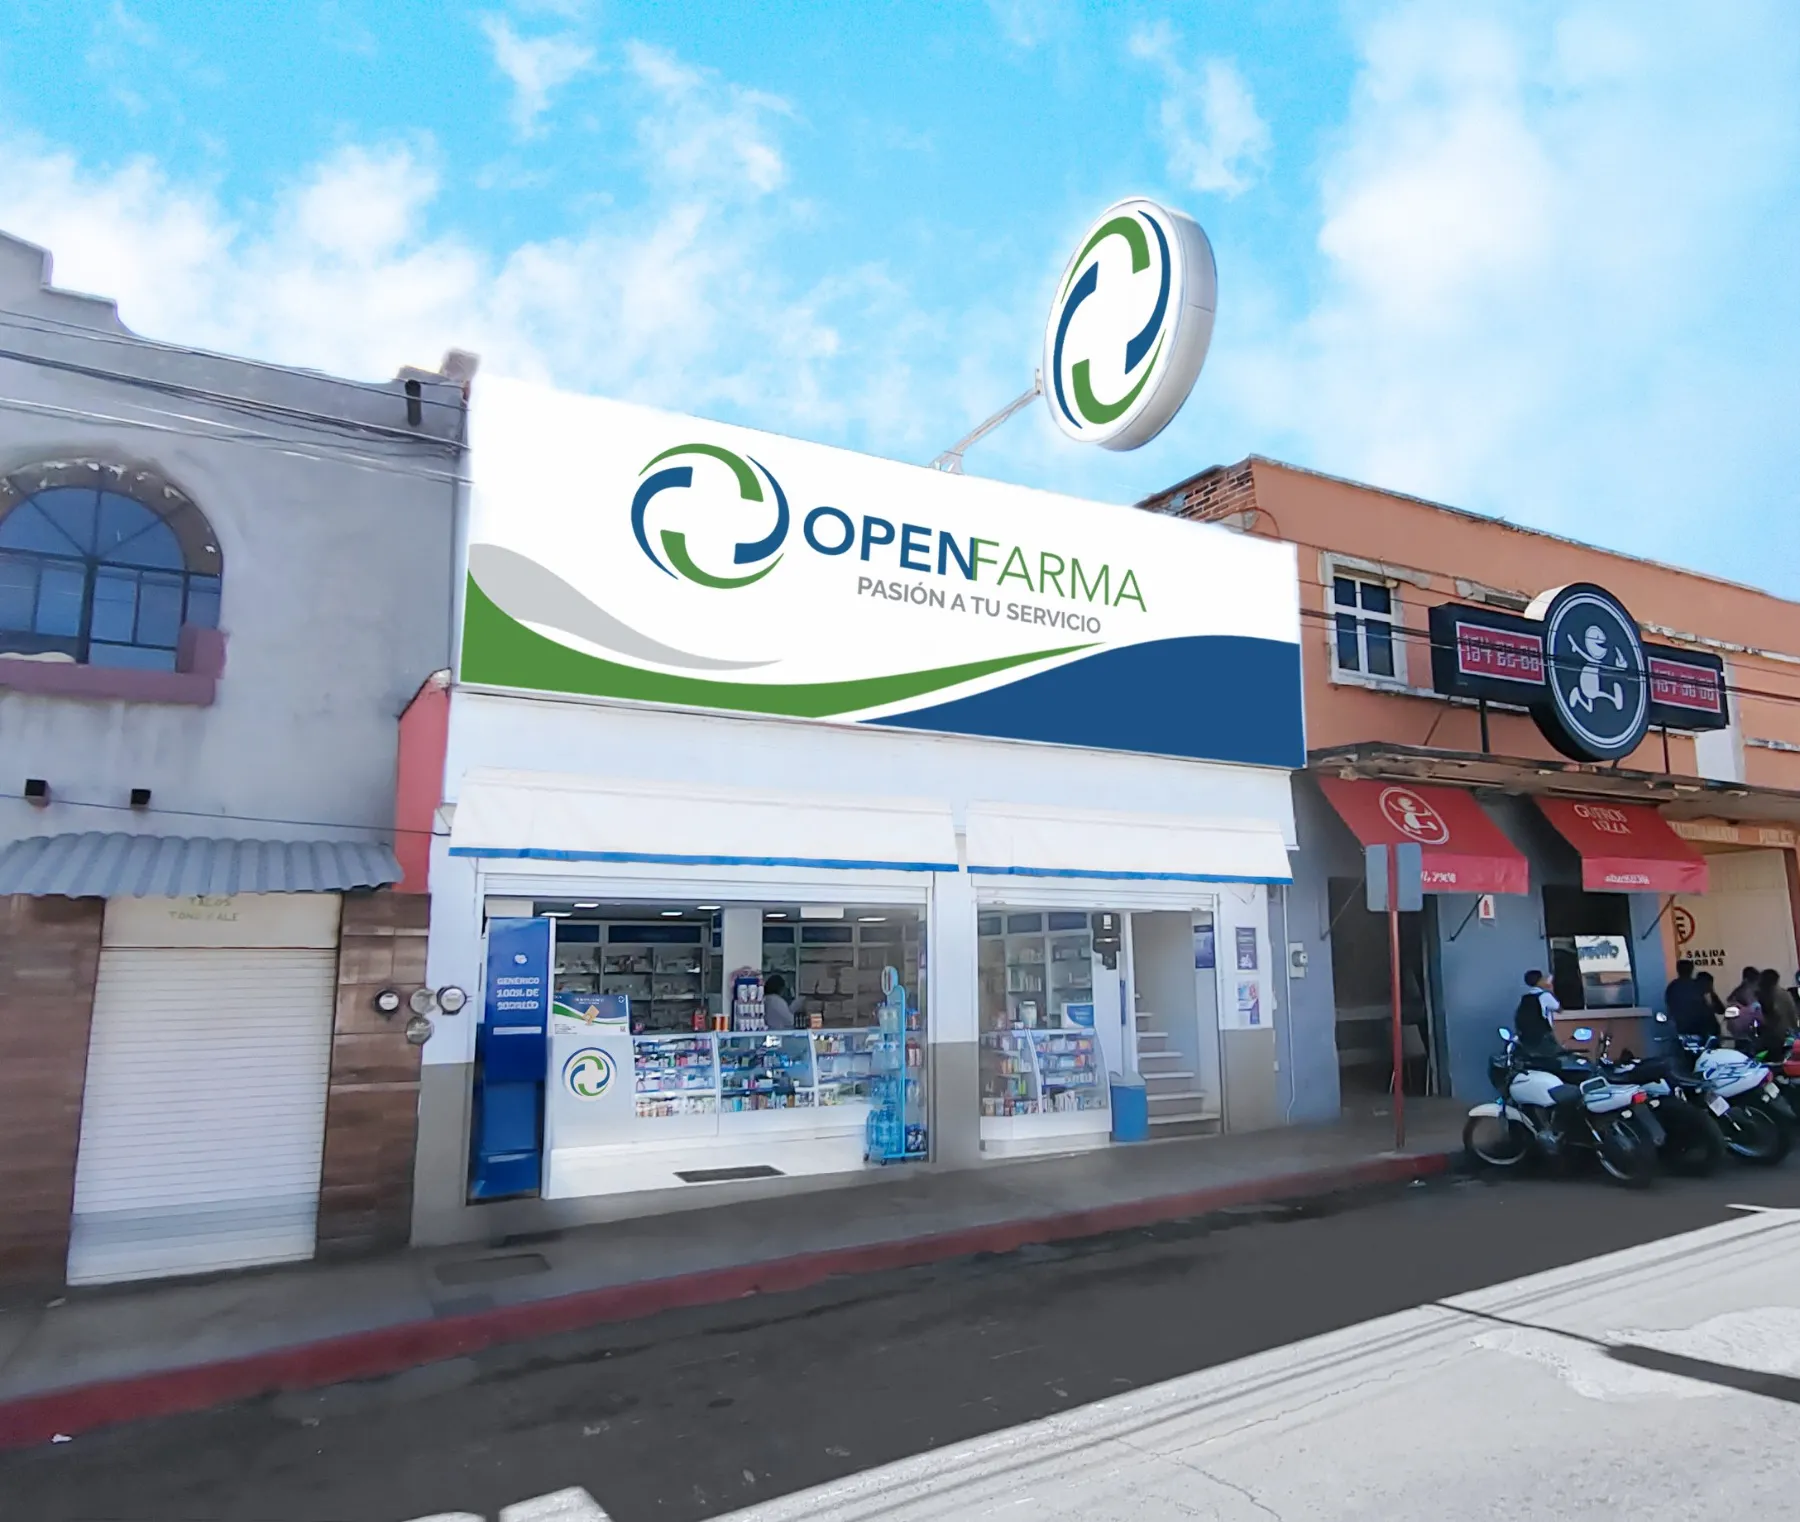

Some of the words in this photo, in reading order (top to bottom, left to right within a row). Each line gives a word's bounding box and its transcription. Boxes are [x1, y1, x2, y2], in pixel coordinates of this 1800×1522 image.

[857, 576, 945, 609] PASIÓN
[950, 593, 967, 612] A
[970, 596, 1001, 617] TU
[1006, 602, 1101, 634] SERVICIO
